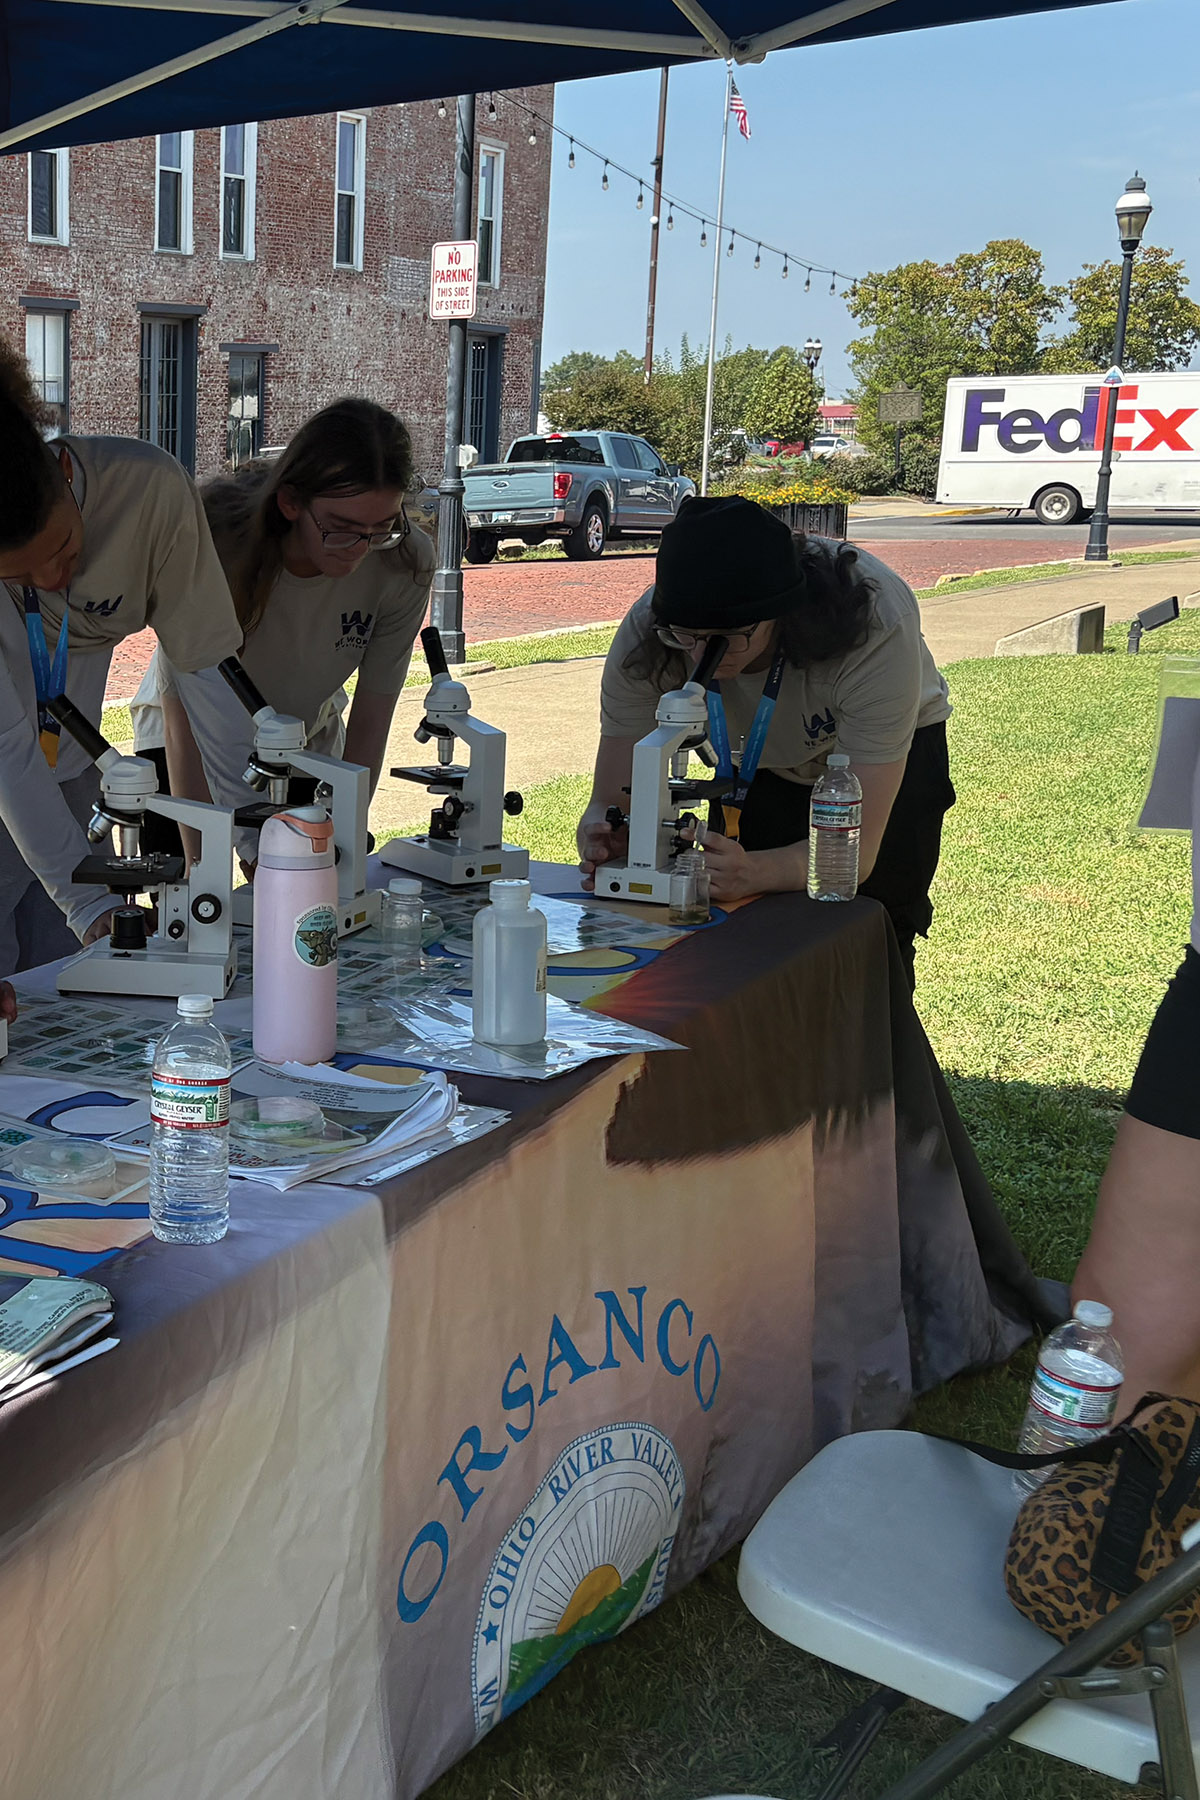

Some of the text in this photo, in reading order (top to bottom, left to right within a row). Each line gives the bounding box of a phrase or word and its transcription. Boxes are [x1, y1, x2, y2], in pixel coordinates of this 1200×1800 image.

[448, 251, 461, 265] NO
[435, 268, 473, 283] PARKING
[437, 286, 469, 297] THIS SIDE
[435, 299, 470, 311] OF STREET
[960, 384, 1199, 454] FedEx
[154, 1100, 203, 1114] CRYSTAL GEYSER
[396, 1285, 721, 1623] ORSANCO
[488, 1432, 681, 1611] OHIO RIVER VALLEY
